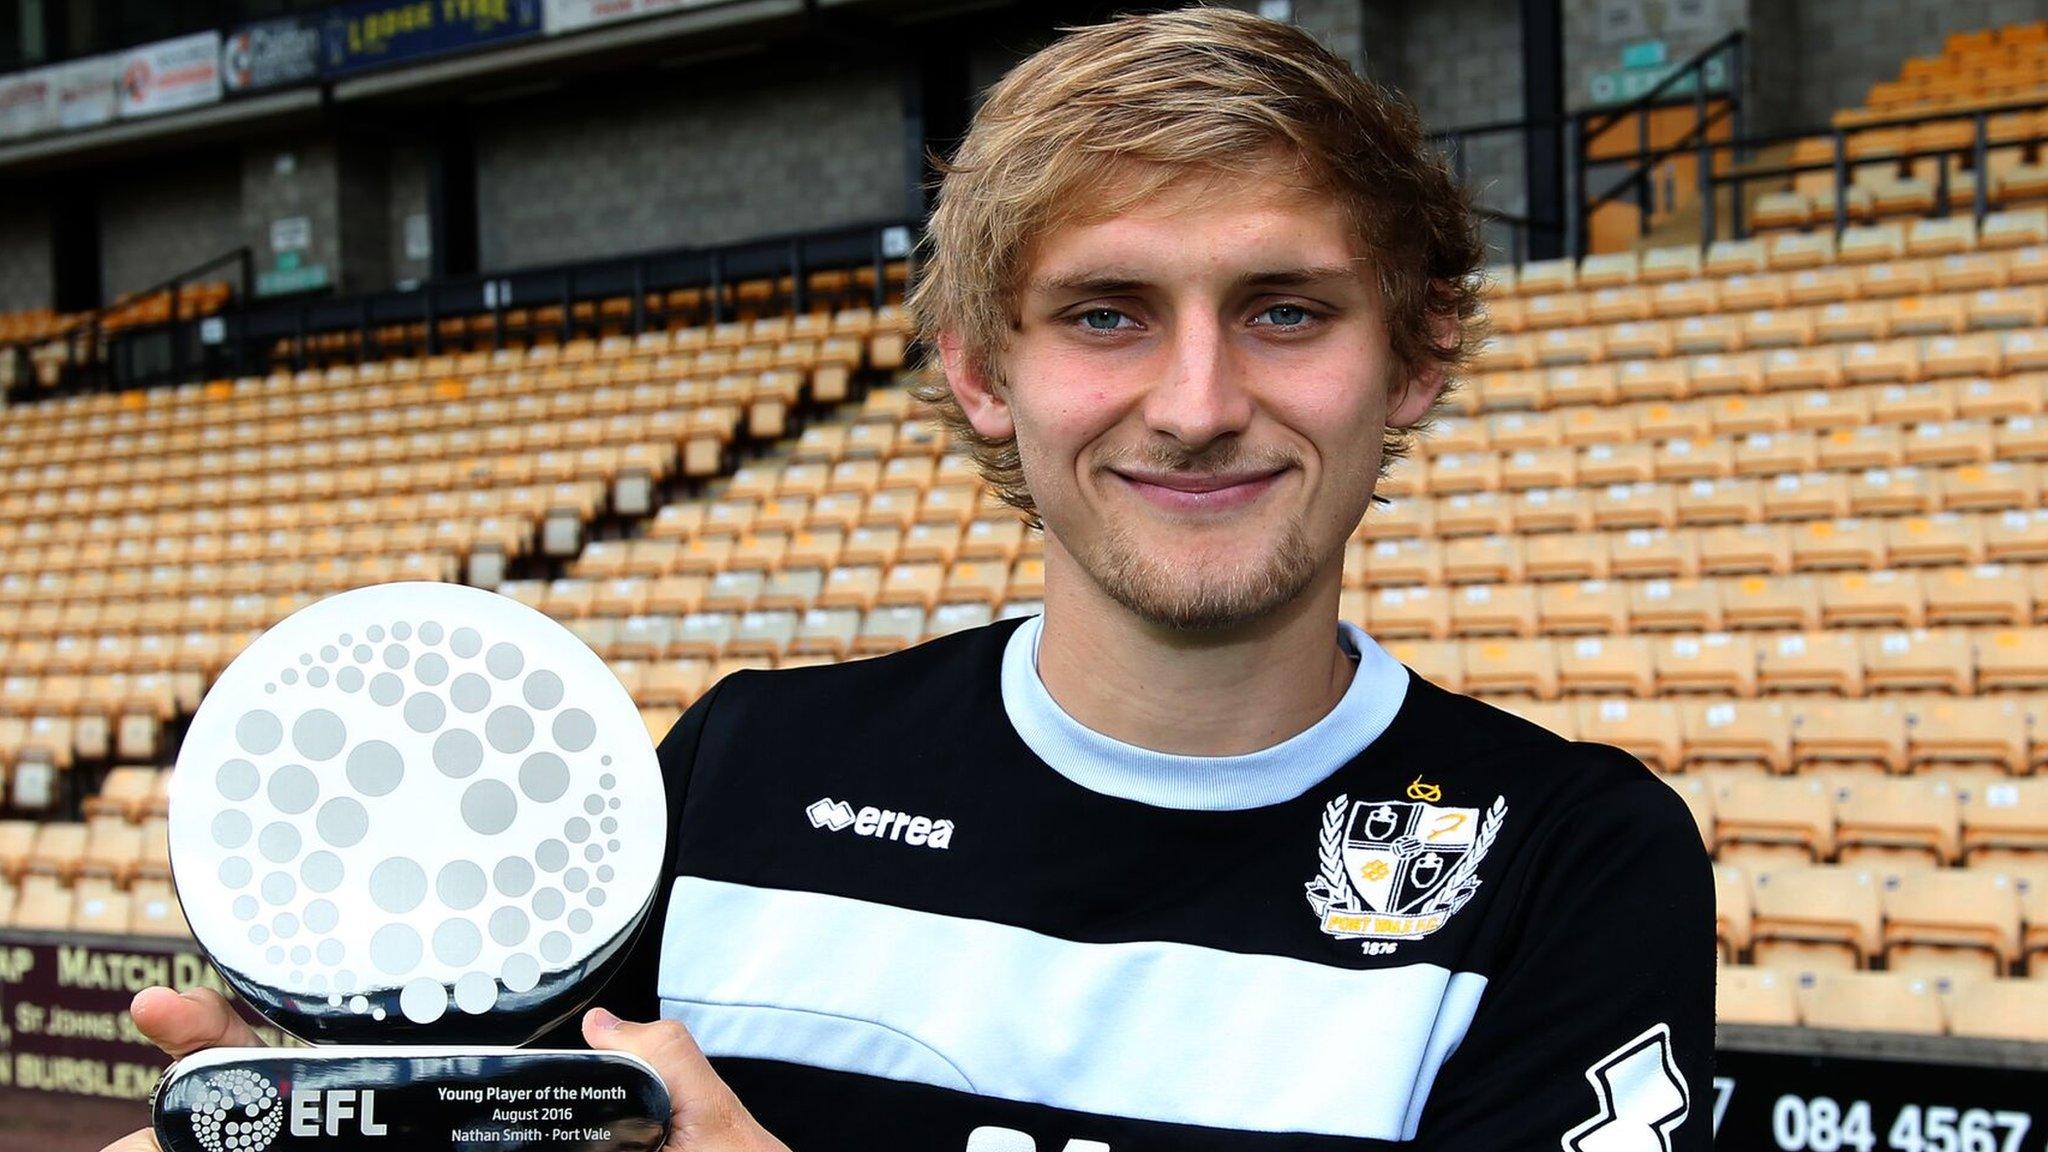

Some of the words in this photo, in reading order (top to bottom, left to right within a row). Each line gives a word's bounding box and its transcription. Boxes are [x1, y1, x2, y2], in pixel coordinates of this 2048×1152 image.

[1361, 941, 1398, 956] 1876
[57, 944, 169, 993] MATCH
[438, 1087, 483, 1103] Young
[487, 1087, 532, 1103] Player
[535, 1087, 551, 1100] of
[554, 1087, 578, 1100] the
[581, 1087, 626, 1100] Month
[290, 1090, 387, 1136] EFL
[492, 1108, 539, 1123] August
[542, 1108, 573, 1120] 2016
[1773, 1094, 1876, 1152] 084
[1888, 1103, 2032, 1152] 4567
[452, 1129, 500, 1142] Nathan
[503, 1129, 542, 1142] Smith
[552, 1129, 580, 1141] Port
[583, 1128, 611, 1141] Vale
